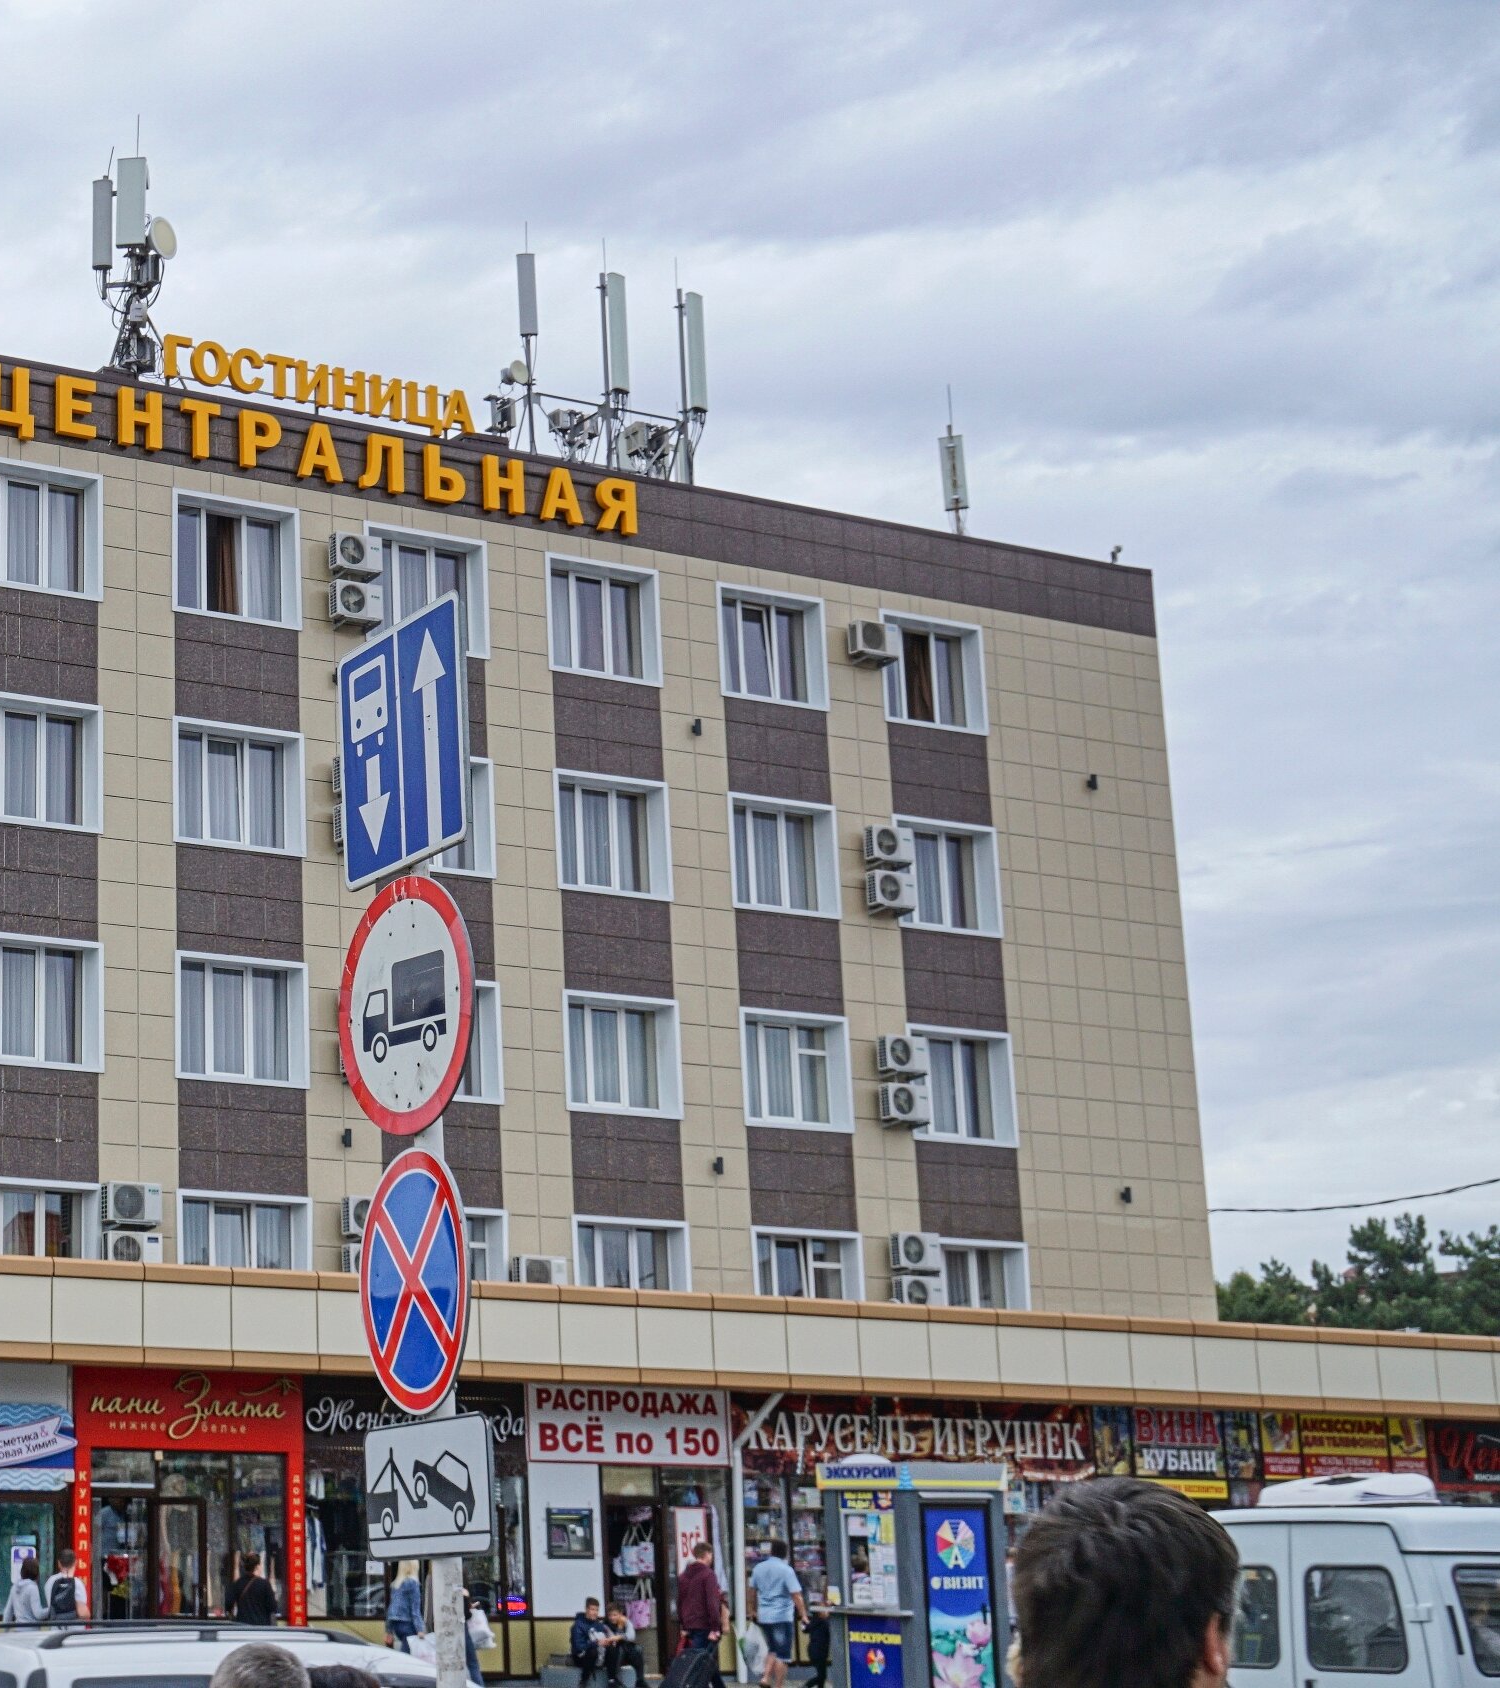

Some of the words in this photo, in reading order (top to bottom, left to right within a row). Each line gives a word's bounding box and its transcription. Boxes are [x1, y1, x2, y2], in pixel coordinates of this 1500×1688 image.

[162, 333, 476, 438] ГОСТИНИЦА
[168, 1370, 286, 1440] Злата
[535, 1387, 718, 1418] РАСПРОДАЖА
[109, 1421, 167, 1432] нижнее
[201, 1421, 248, 1434] белье
[538, 1415, 605, 1453] ВСЁ
[615, 1432, 654, 1454] по
[665, 1426, 720, 1457] 150
[747, 1408, 916, 1455] КАРУСЕЛЬ
[932, 1416, 1085, 1461] ИГРУШЕК
[1135, 1408, 1221, 1446] ВИНА
[1302, 1417, 1386, 1434] АКСЕССУАРЫ
[24, 1437, 58, 1454] Химия
[1141, 1448, 1218, 1473] КУБАНИ
[825, 1466, 897, 1479] ЭКСКУРСИИ
[78, 1470, 88, 1583] КУПАЛЬ
[293, 1572, 303, 1626] ОДЕЖД
